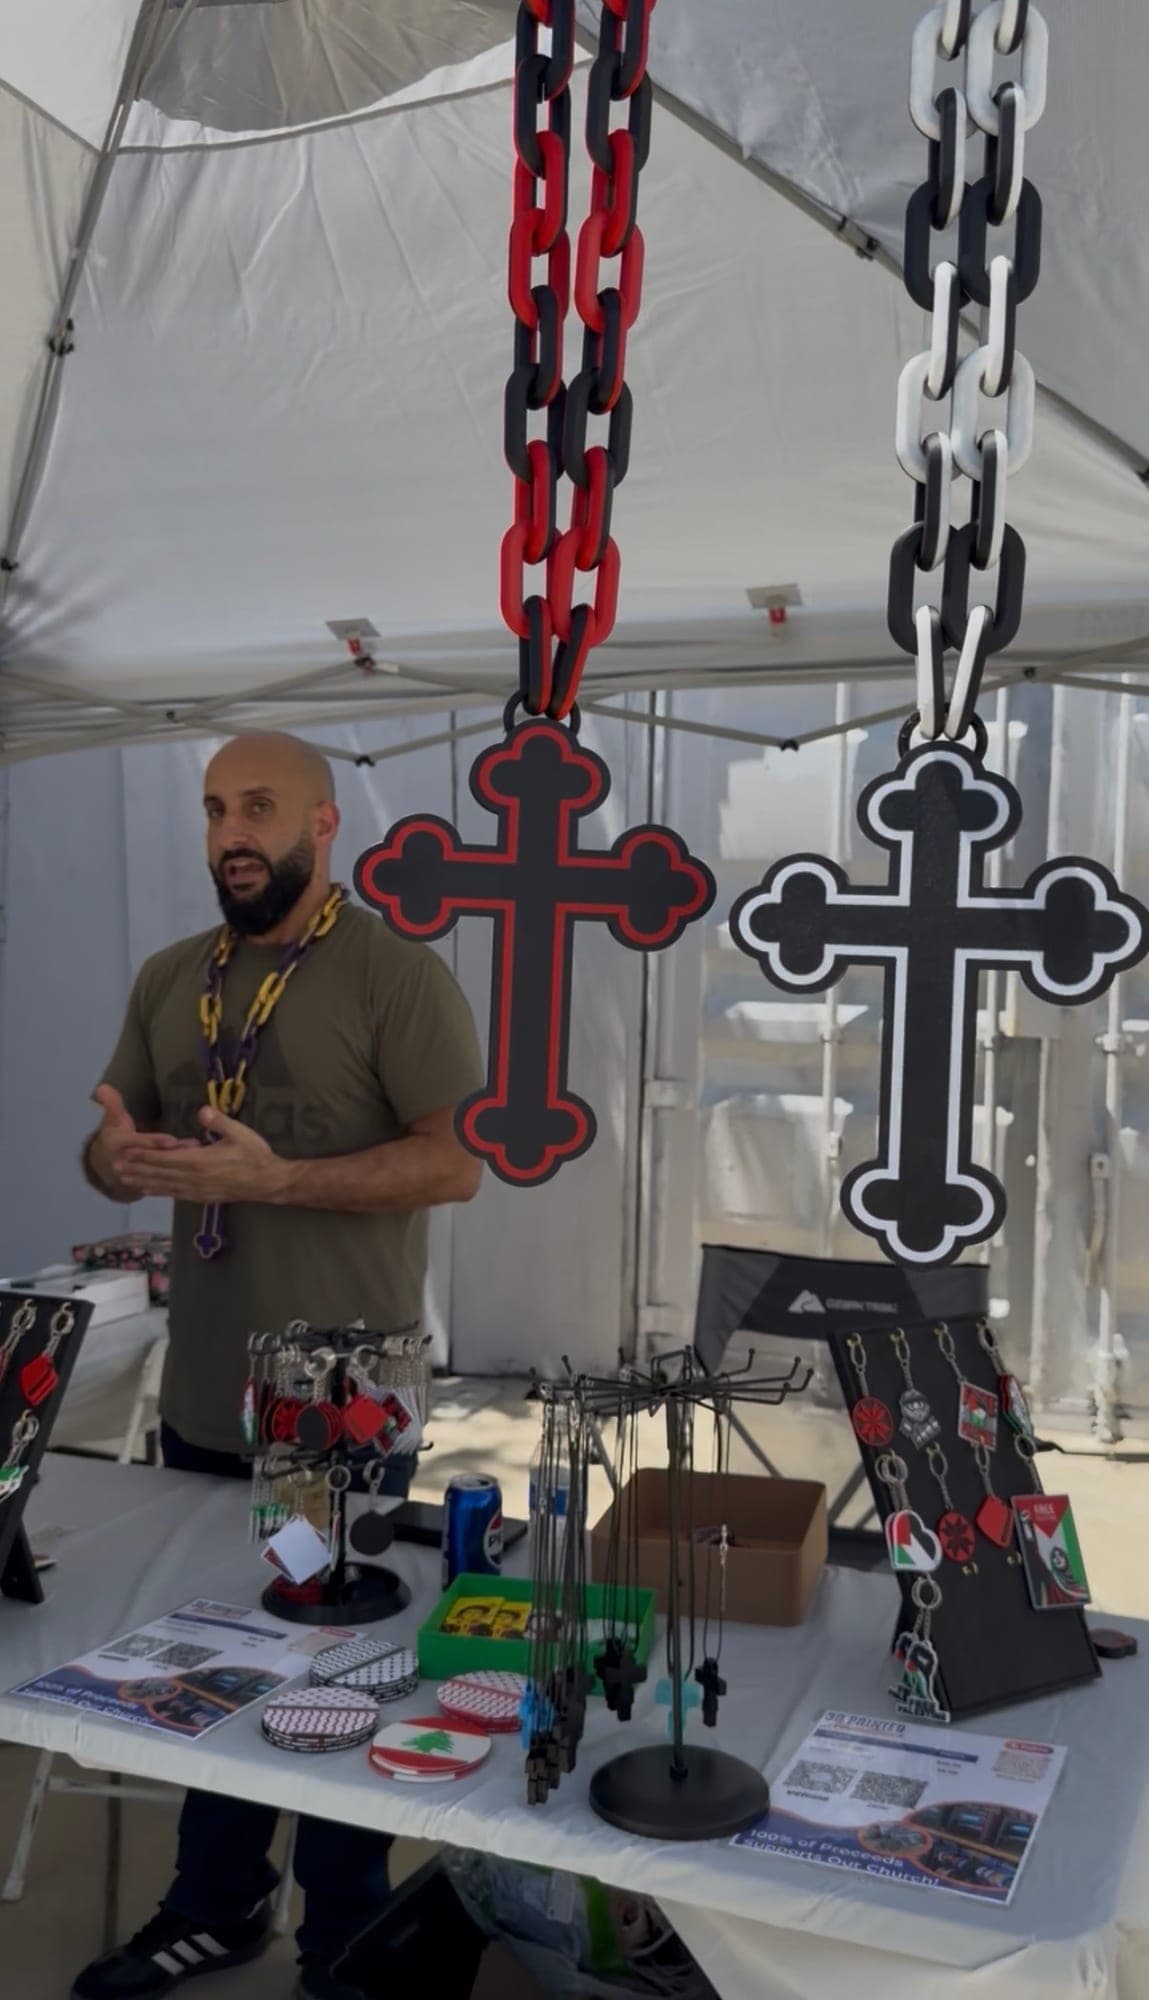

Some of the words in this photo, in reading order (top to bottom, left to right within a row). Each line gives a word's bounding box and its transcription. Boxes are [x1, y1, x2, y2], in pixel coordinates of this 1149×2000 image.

[849, 1715, 906, 1733] PRINTED
[749, 1829, 793, 1845] 100%
[798, 1837, 816, 1848] of
[820, 1842, 904, 1867] Proceeds
[827, 1854, 862, 1870] Our
[866, 1862, 940, 1886] Church!
